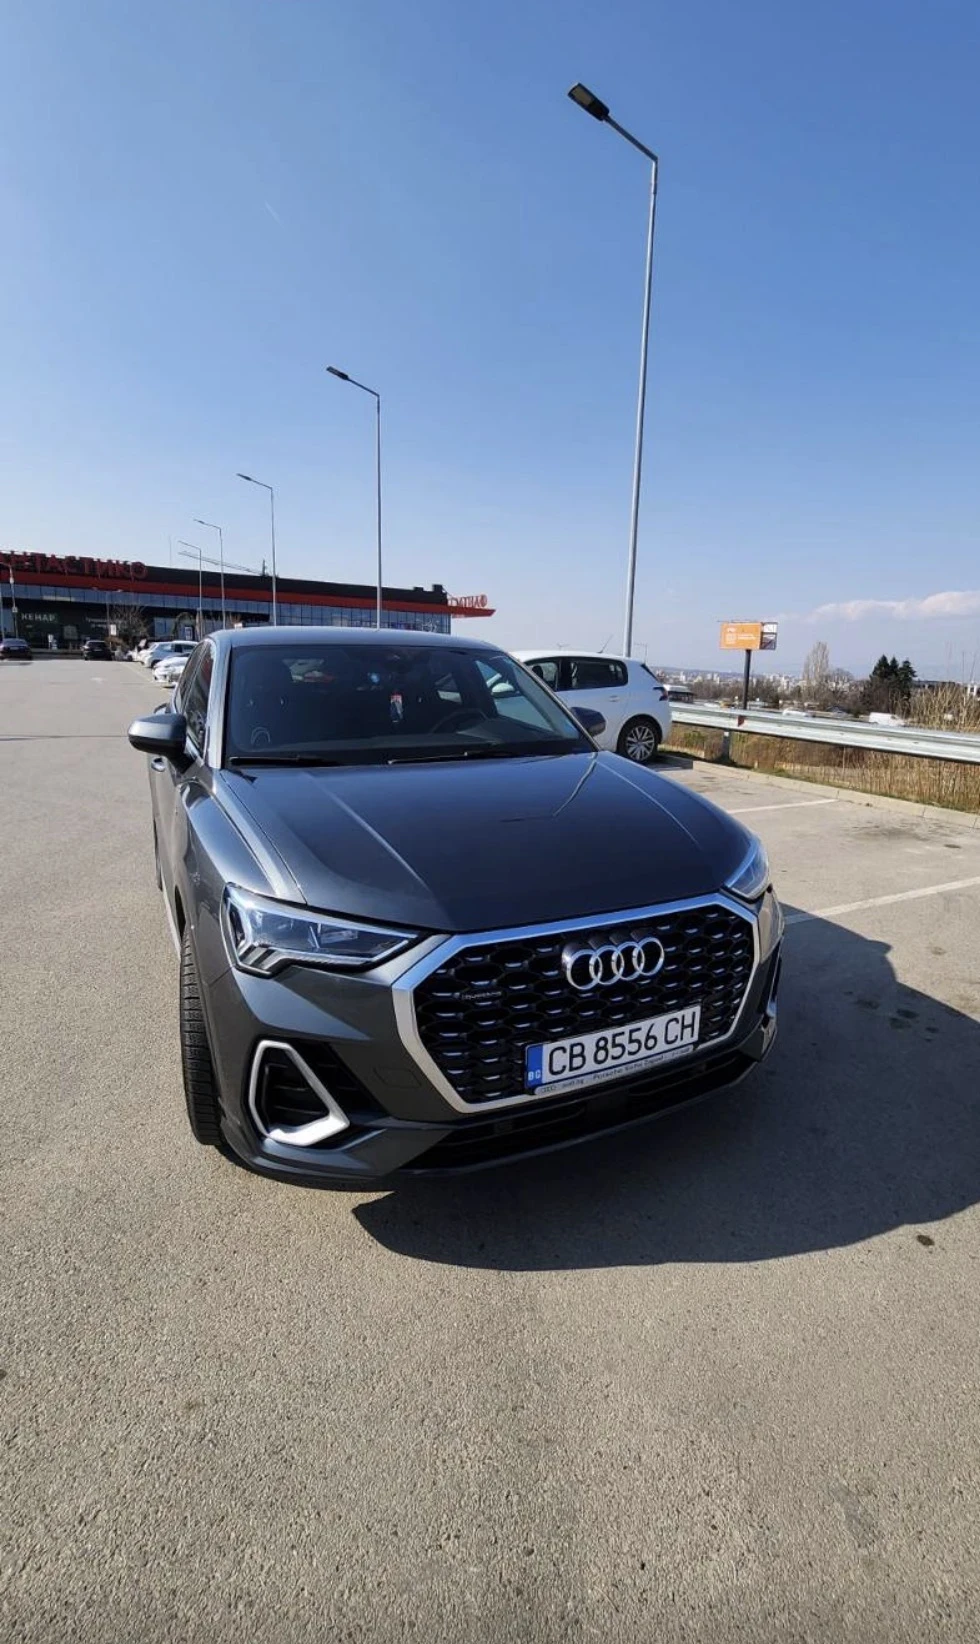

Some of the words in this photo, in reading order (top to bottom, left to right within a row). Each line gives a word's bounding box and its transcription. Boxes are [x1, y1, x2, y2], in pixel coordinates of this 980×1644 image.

[548, 1041, 587, 1076] CB
[593, 1023, 658, 1065] 8556
[664, 1011, 696, 1045] CH
[527, 1069, 542, 1082] BG
